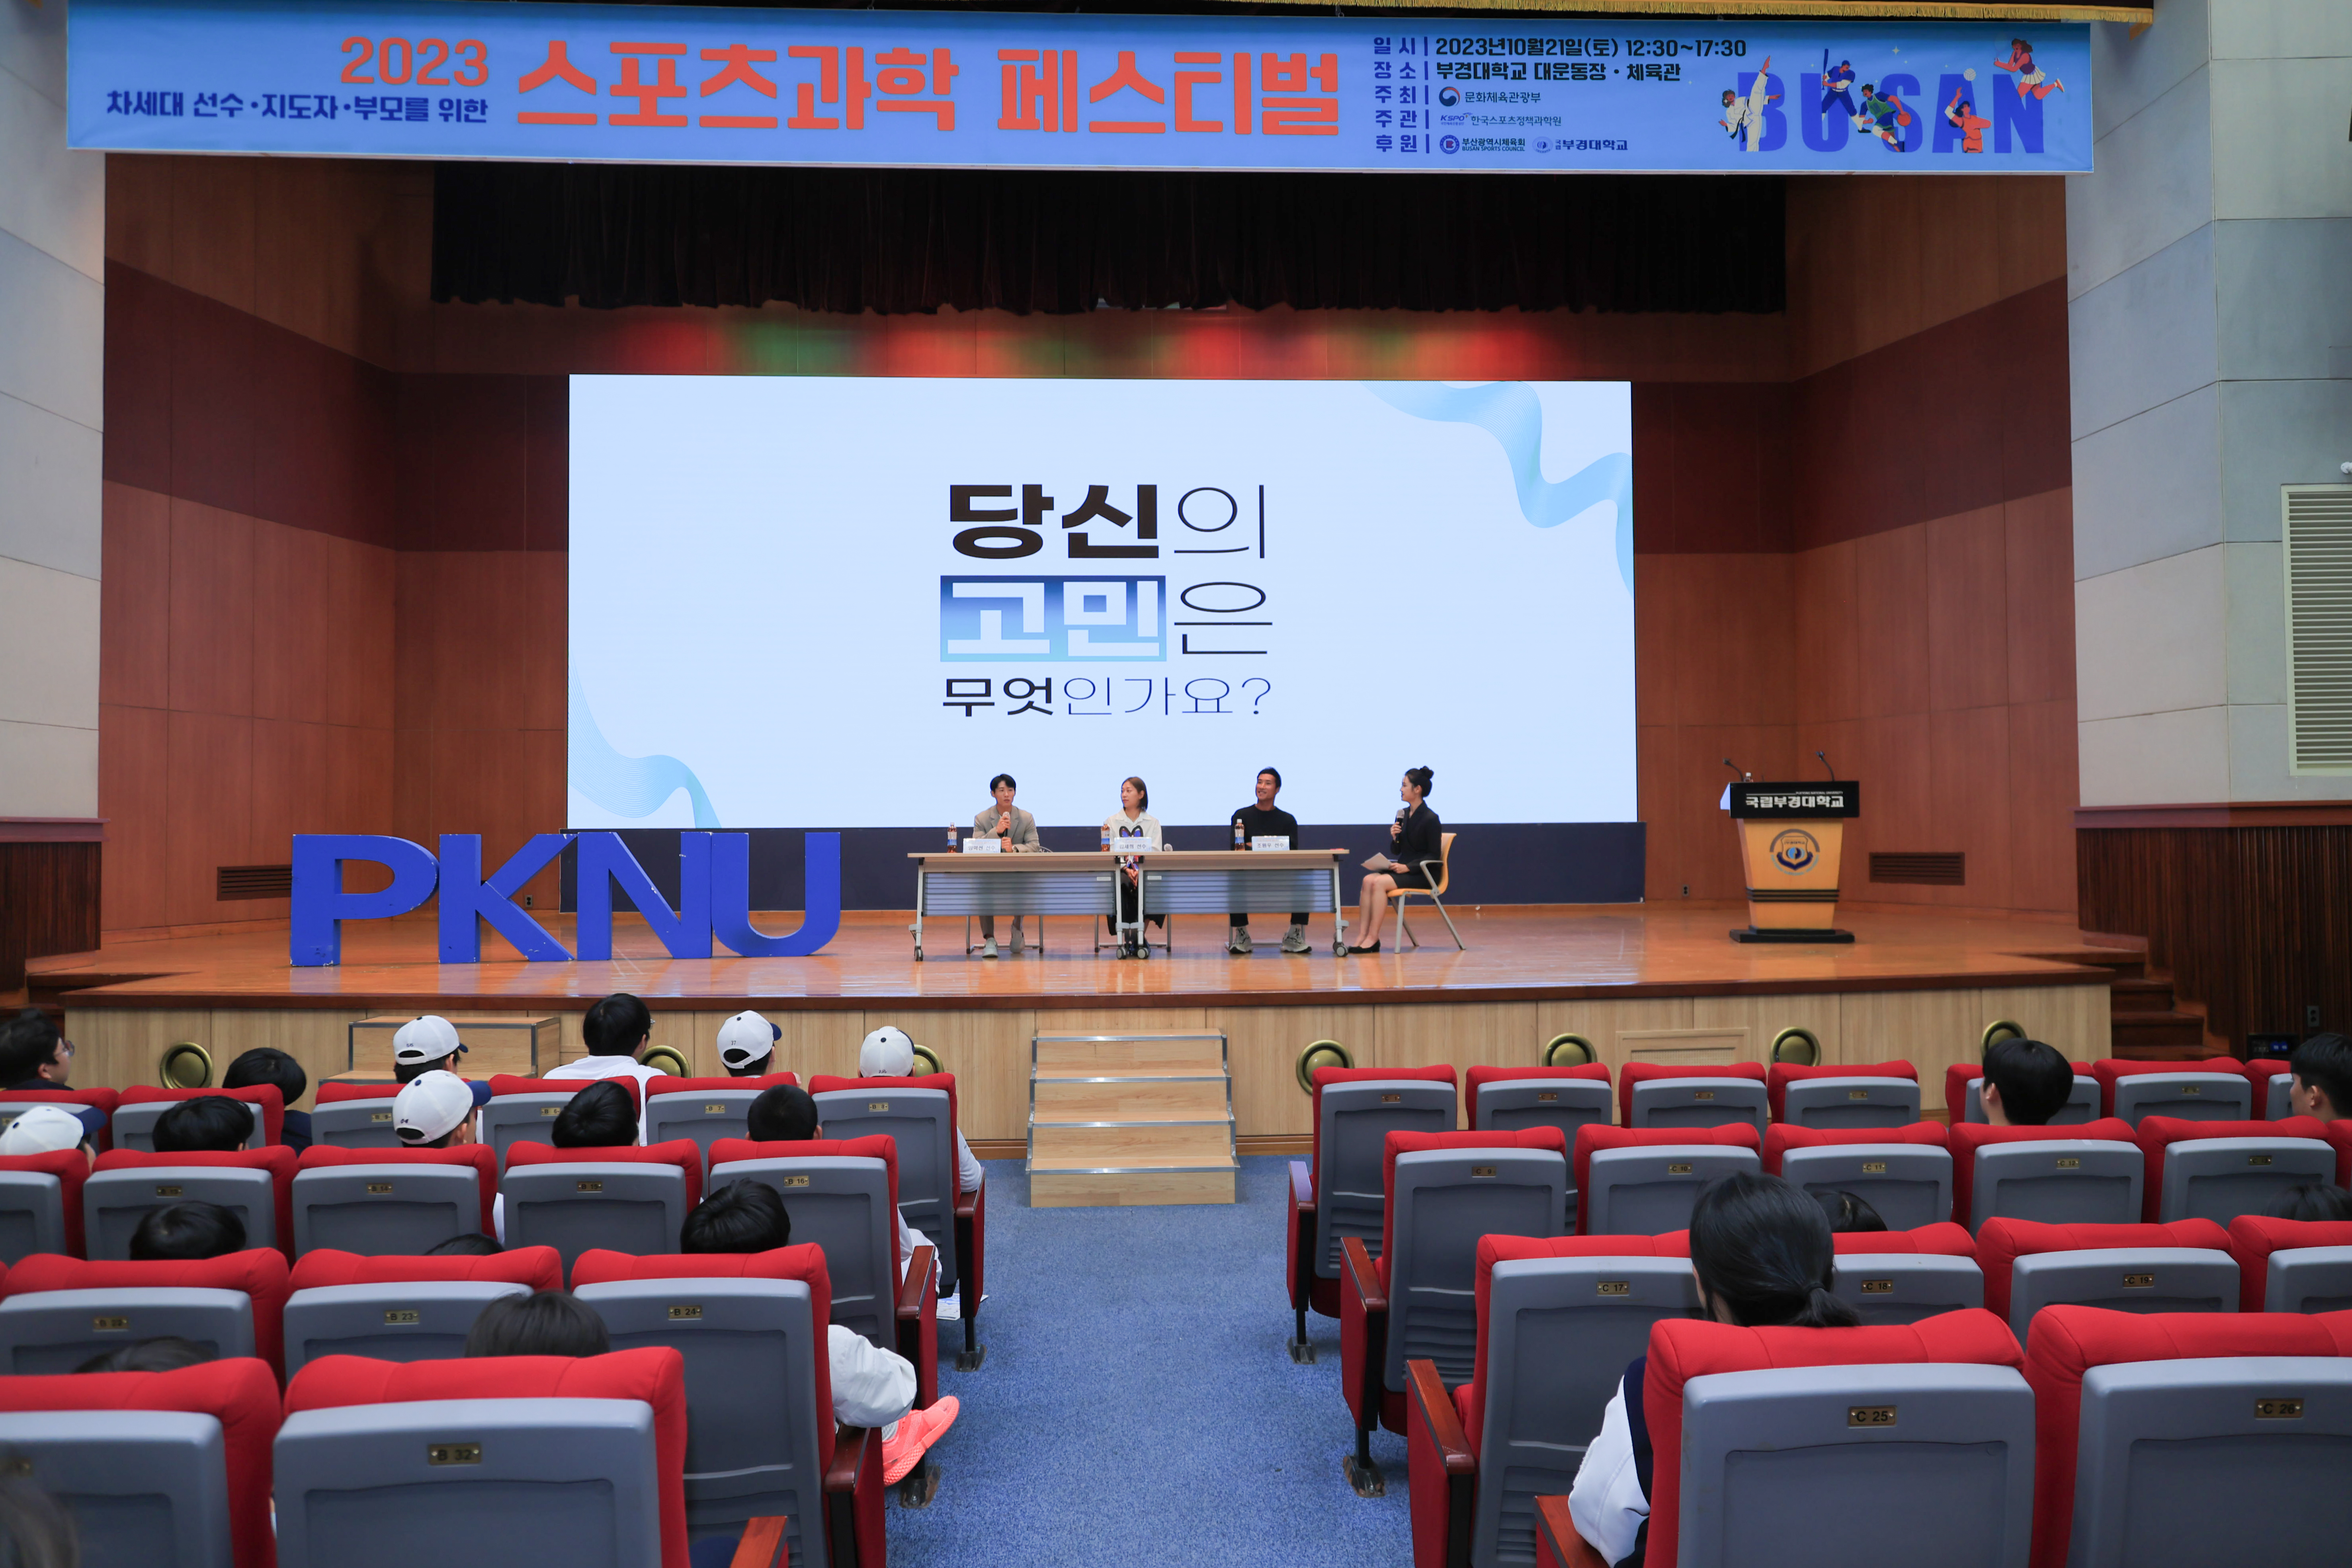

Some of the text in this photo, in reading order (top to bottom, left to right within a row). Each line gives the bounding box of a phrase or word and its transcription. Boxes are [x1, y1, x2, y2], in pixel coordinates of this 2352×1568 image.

[1625, 39, 1746, 57] 12:30~17:30
[341, 36, 488, 86] 2023
[1437, 62, 1681, 81] 부경대학교 대운동장 체육관
[517, 40, 1339, 135] 스포츠과학 페스티벌
[107, 90, 184, 116] 차세대
[439, 98, 488, 123] 위한
[1465, 92, 1541, 103] 문화체육관광부
[1471, 115, 1561, 127] 한국스포츠정책과학원
[1737, 72, 2045, 154] BUSAN
[1462, 138, 1525, 146] 부산광역시체육회
[1563, 139, 1628, 150] 부경대학교
[950, 484, 1265, 559] 당신의
[947, 580, 1273, 657] 고민은
[943, 677, 1271, 717] 무엇인가요?
[1746, 795, 1844, 808] 국립부경대학교
[290, 832, 841, 967] PKNU
[1857, 1411, 1888, 1422] C 25
[2264, 1403, 2295, 1414] C 26
[438, 1449, 471, 1461] B 32
